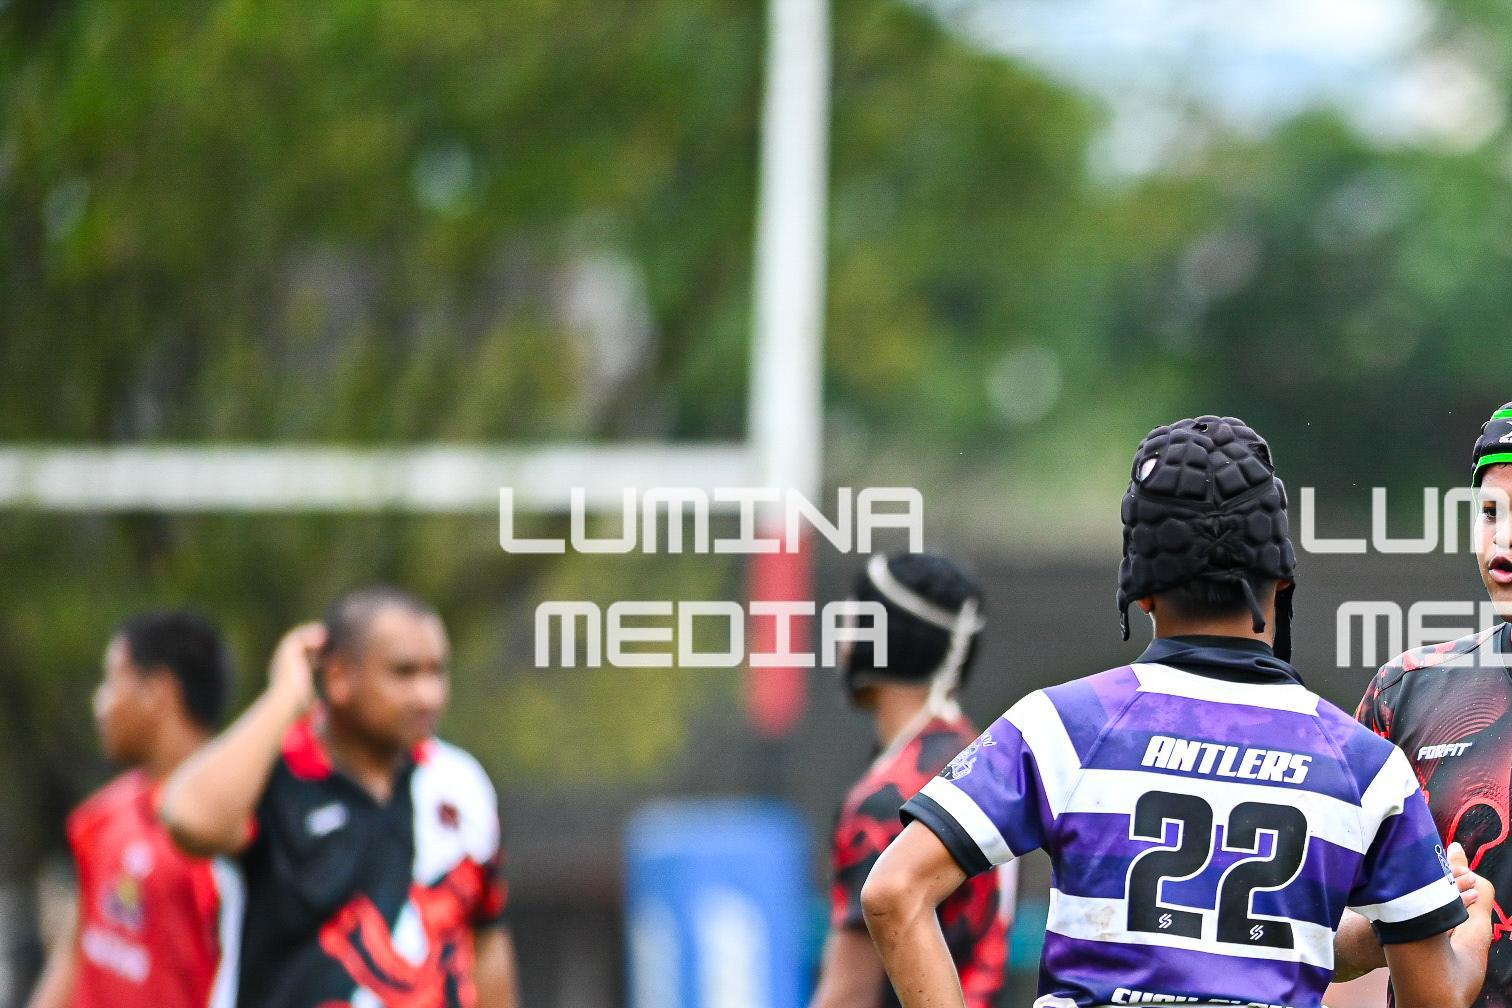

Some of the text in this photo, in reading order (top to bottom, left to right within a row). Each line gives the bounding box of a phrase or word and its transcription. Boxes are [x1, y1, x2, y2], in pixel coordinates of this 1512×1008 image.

[1141, 735, 1313, 784] ANTLERS
[1417, 742, 1472, 760] FORFIT
[1125, 789, 1310, 950] 22
